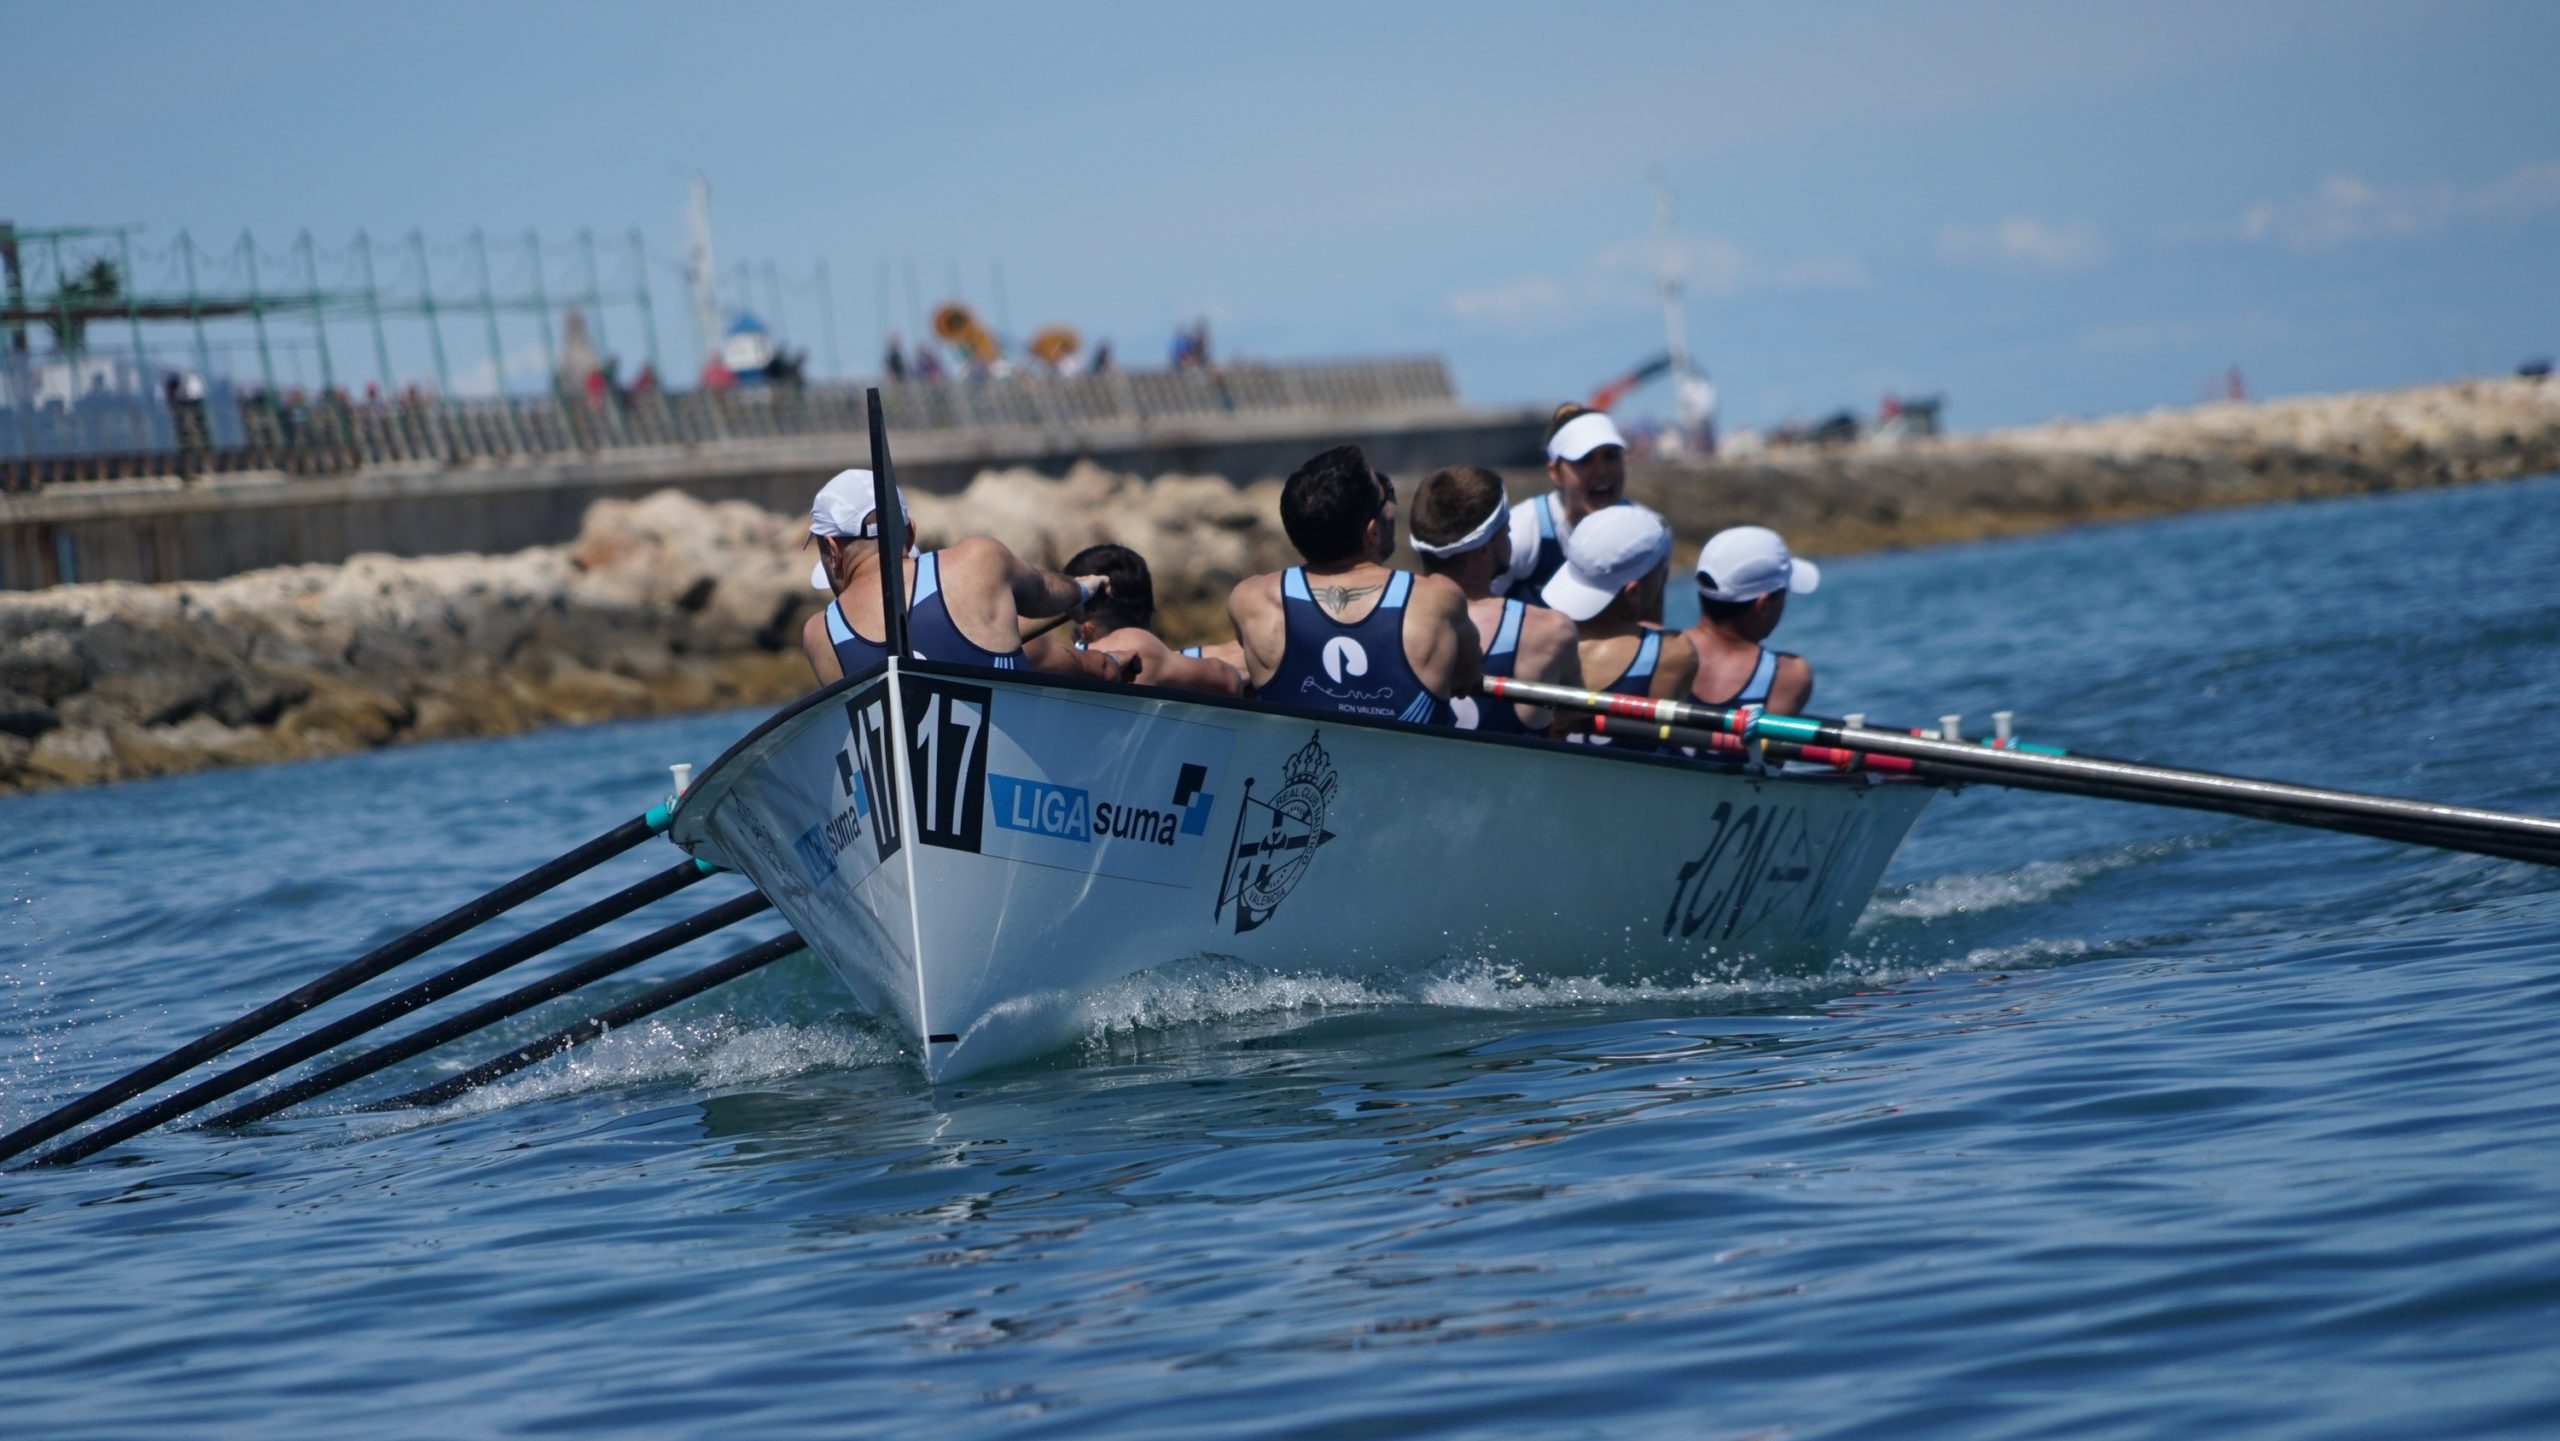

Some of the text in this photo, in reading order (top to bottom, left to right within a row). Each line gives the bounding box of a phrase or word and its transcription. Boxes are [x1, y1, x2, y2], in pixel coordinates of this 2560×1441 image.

[1338, 703, 1396, 716] RCN VALENCIA
[857, 700, 896, 845] 17
[917, 692, 982, 837] 17
[1012, 784, 1178, 846] LIGA suma
[1276, 787, 1299, 807] REAL
[1301, 786, 1320, 808] CLUB
[825, 805, 862, 857] suma
